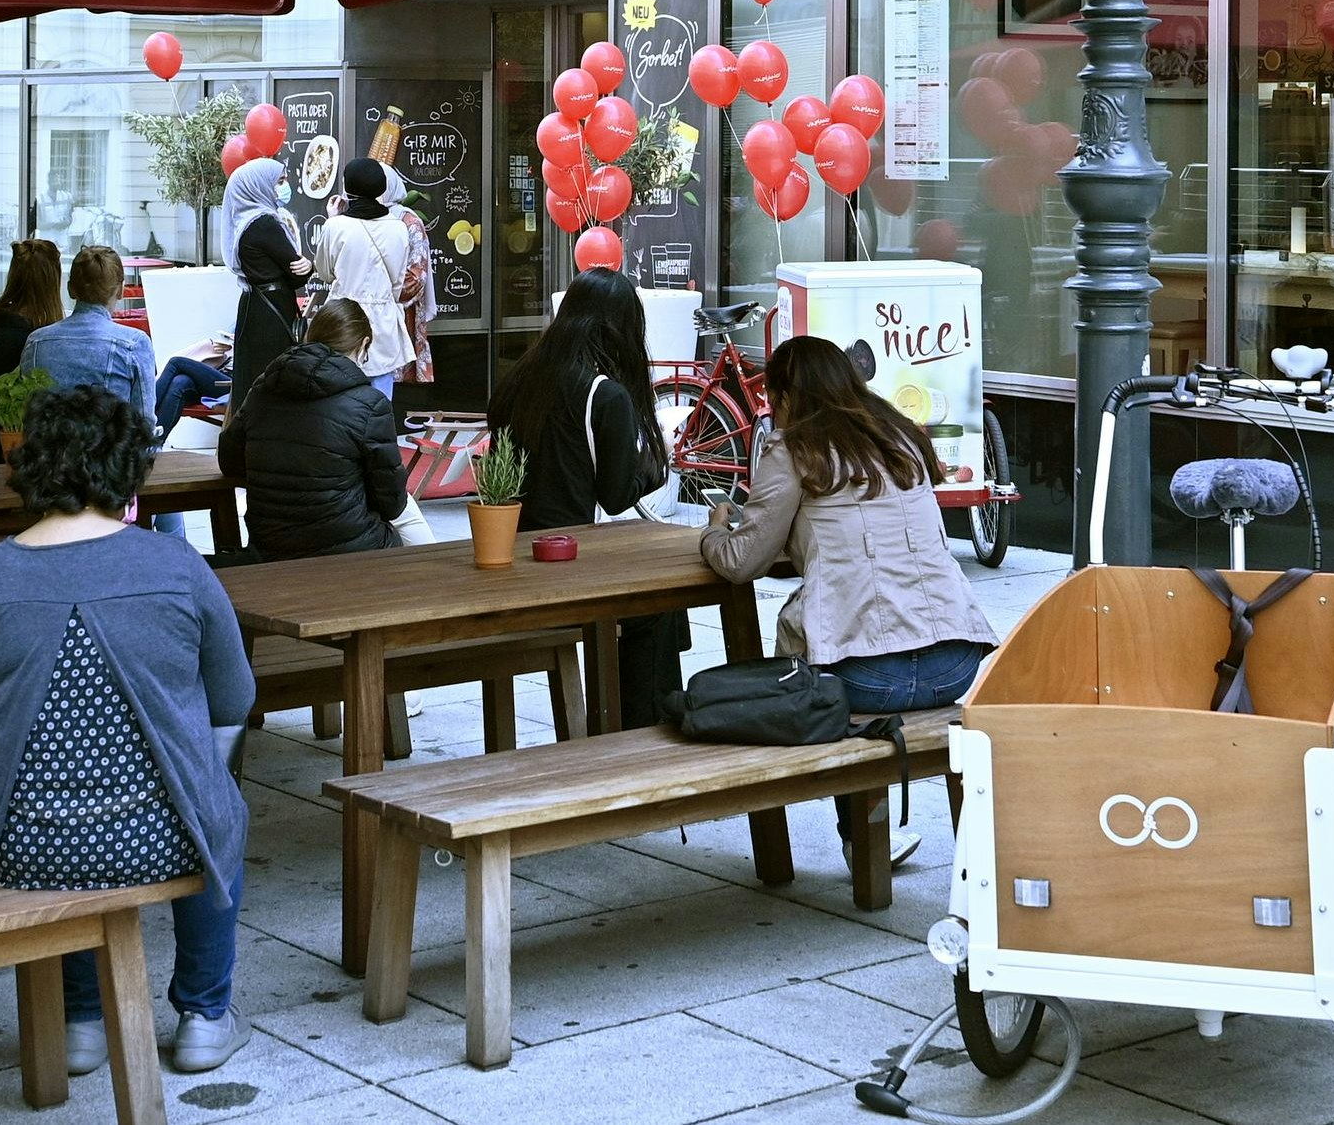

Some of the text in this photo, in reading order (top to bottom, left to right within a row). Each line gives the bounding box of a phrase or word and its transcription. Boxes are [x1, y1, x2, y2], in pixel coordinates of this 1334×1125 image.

[632, 6, 650, 19] NEU
[635, 38, 688, 79] Sorbet!
[288, 103, 328, 117] PASTA ODER
[296, 120, 318, 134] PIZZA?
[403, 134, 428, 149] GIB
[431, 134, 457, 149] MIR
[410, 149, 446, 166] FÜNF!
[875, 302, 902, 328] so
